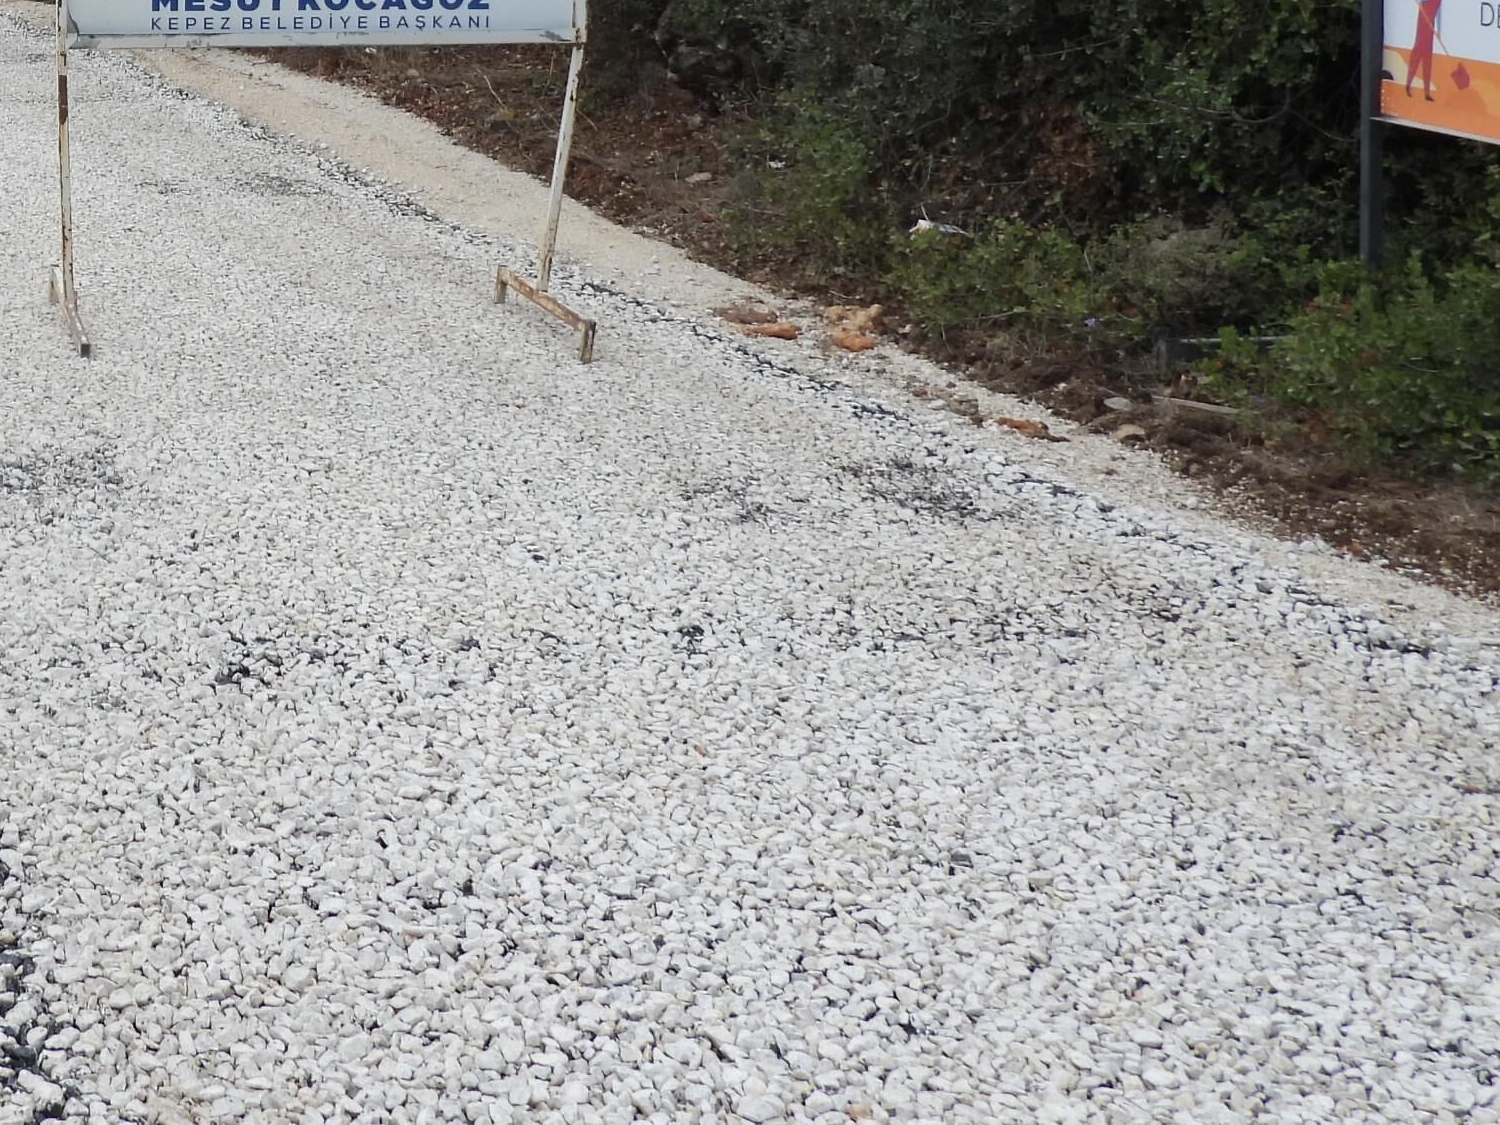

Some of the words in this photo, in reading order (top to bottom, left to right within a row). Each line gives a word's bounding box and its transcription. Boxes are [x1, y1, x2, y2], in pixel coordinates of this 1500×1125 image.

[1480, 2, 1500, 21] D
[151, 17, 232, 30] KEPEZ
[241, 13, 369, 30] BELEDİYE
[379, 15, 491, 31] BAŞKANI
